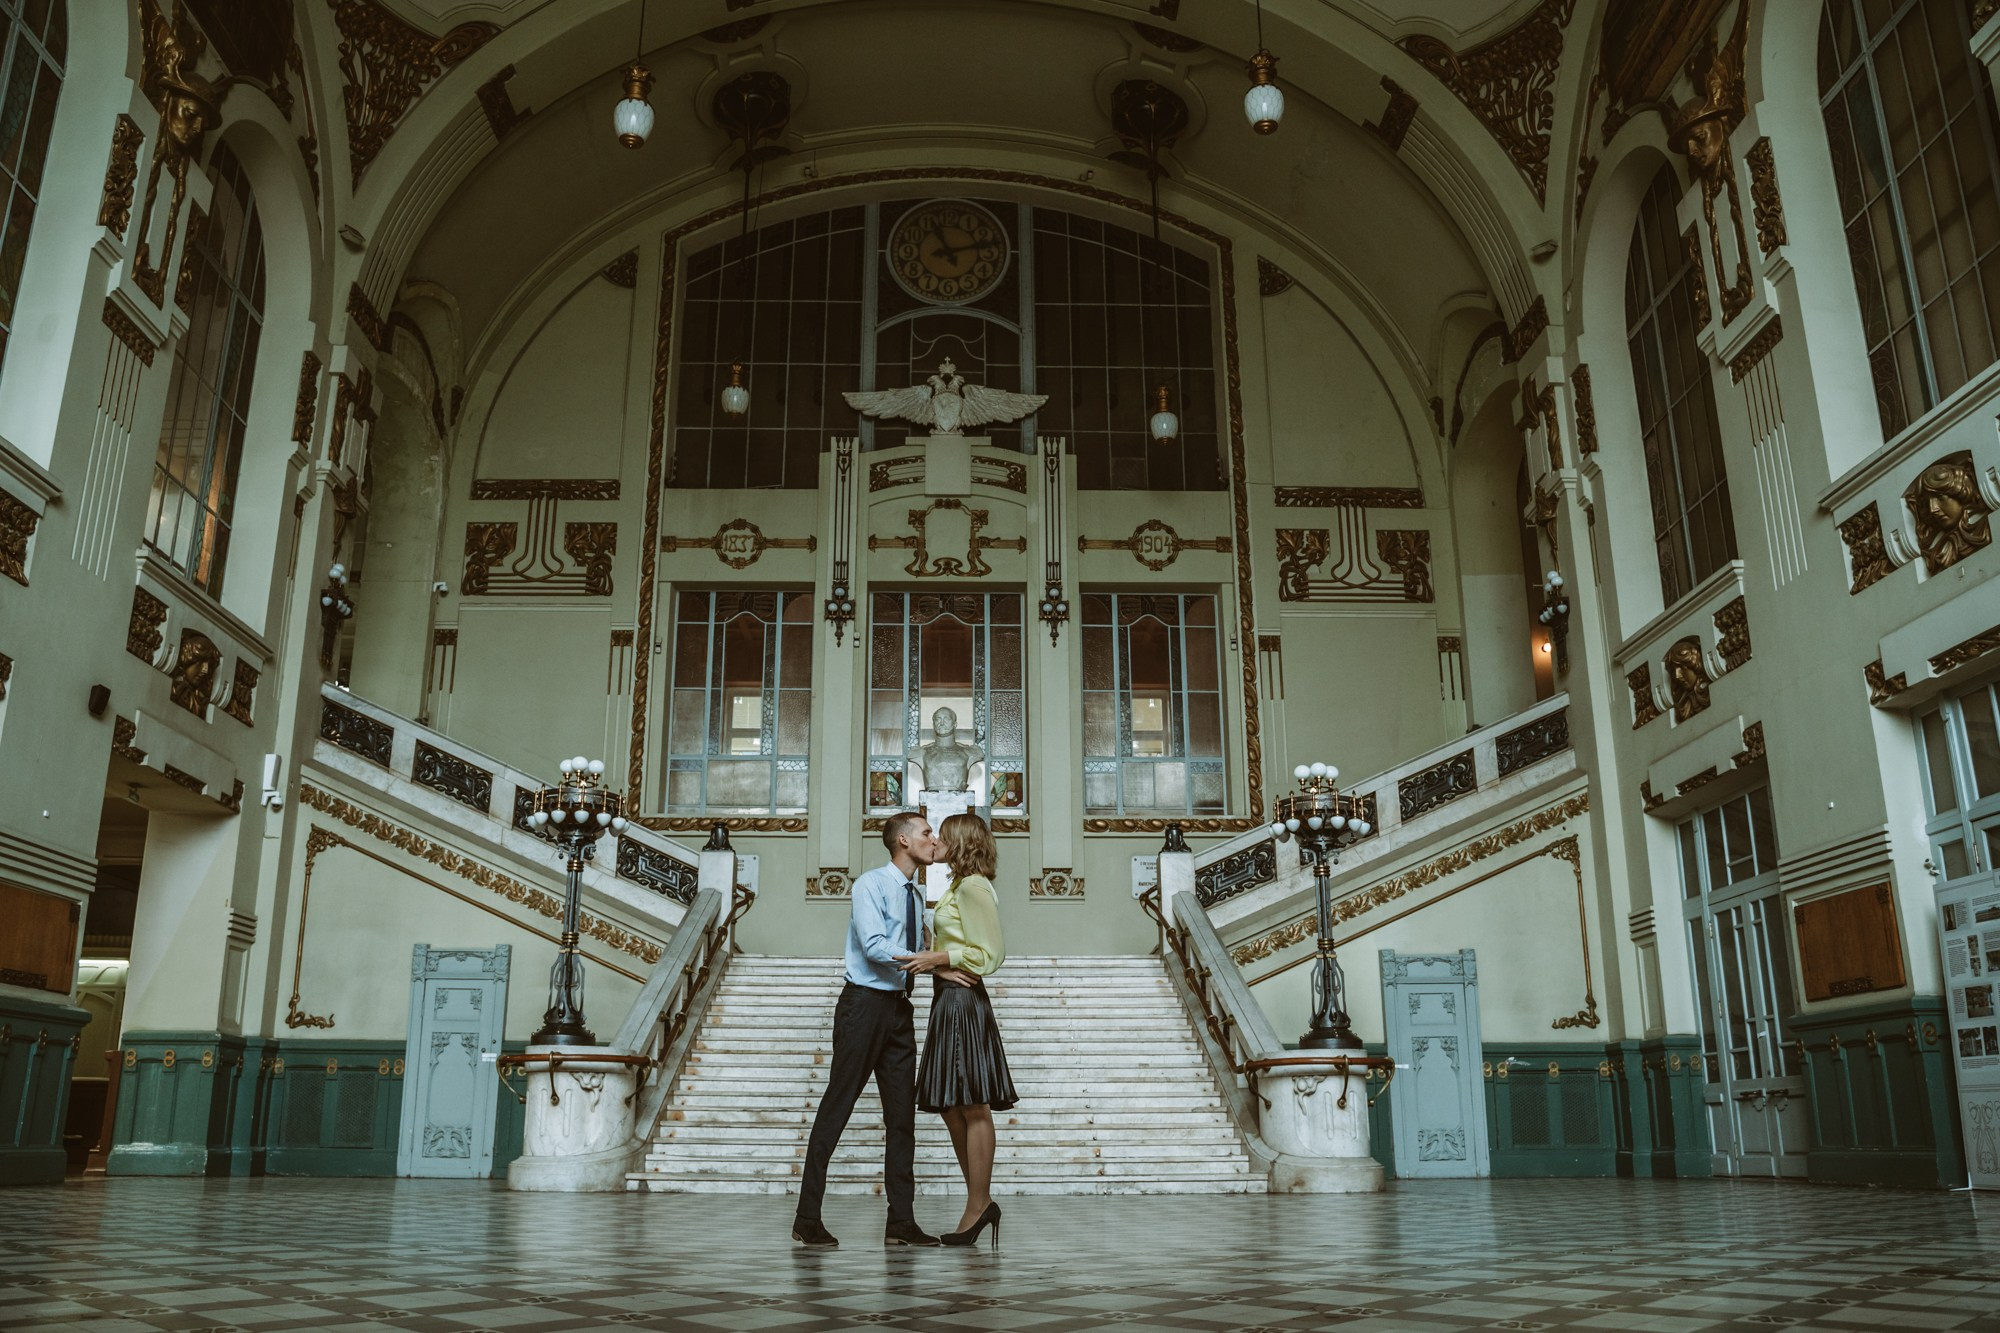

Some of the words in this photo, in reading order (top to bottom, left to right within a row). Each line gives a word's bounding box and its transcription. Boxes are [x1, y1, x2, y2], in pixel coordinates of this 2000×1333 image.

[941, 210, 956, 225] 12
[907, 228, 921, 241] 10
[903, 245, 913, 259] 9
[909, 263, 919, 276] 8
[978, 264, 987, 276] 4
[924, 276, 932, 288] 7
[944, 280, 953, 293] 6
[964, 276, 973, 289] 5
[1138, 536, 1172, 553] 1904
